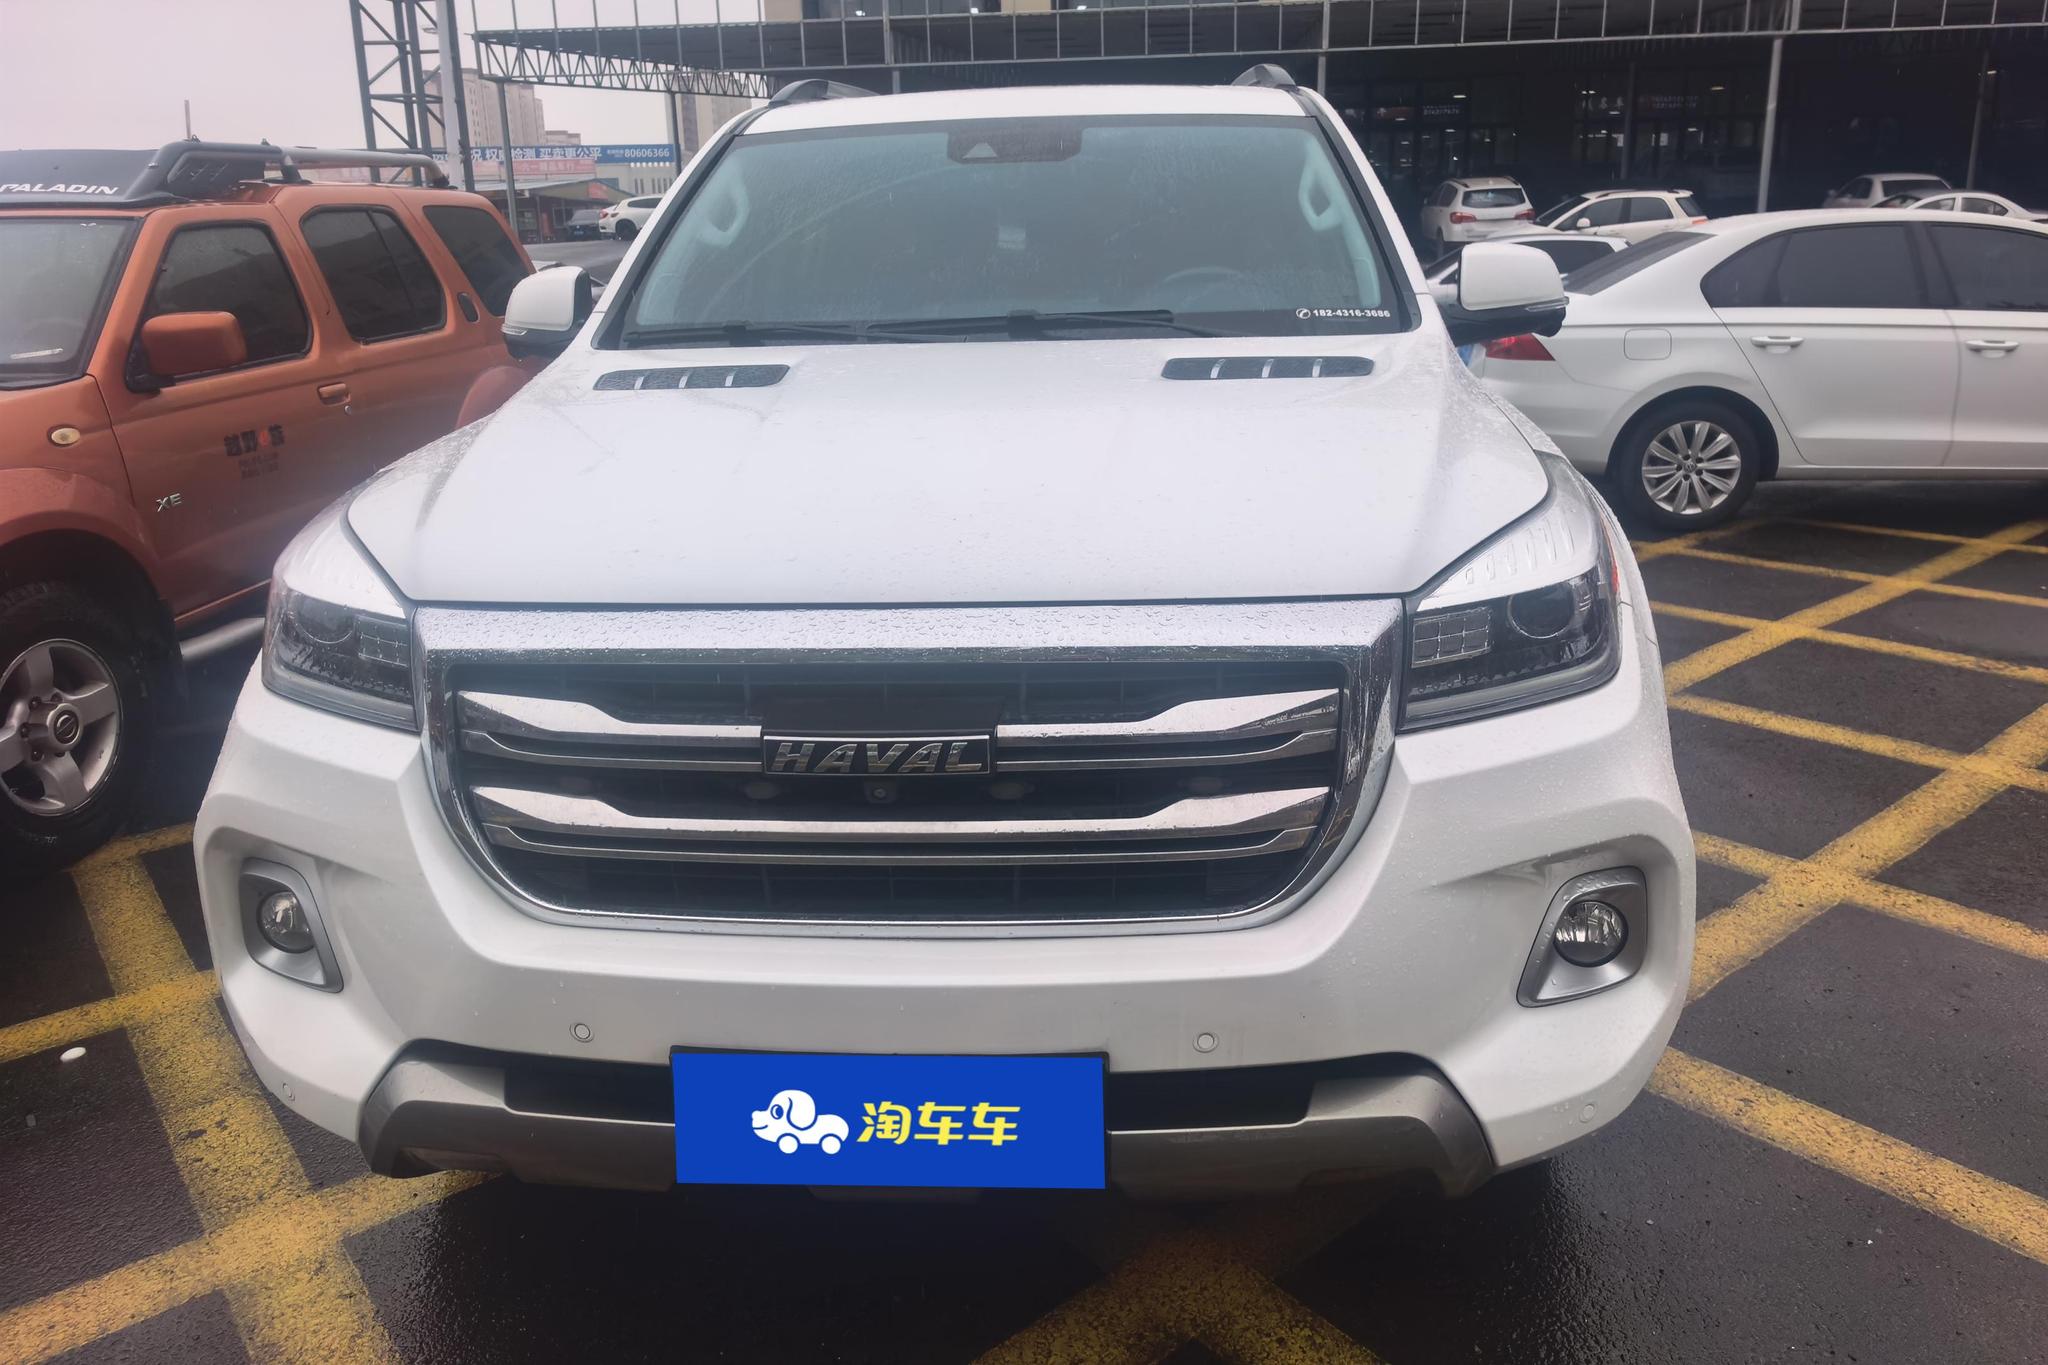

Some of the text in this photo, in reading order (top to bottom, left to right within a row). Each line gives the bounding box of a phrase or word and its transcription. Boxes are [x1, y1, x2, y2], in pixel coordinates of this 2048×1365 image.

[624, 148, 670, 158] 80606366
[0, 183, 119, 195] PALADIN
[156, 493, 183, 512] XE
[770, 742, 982, 773] HAVAL
